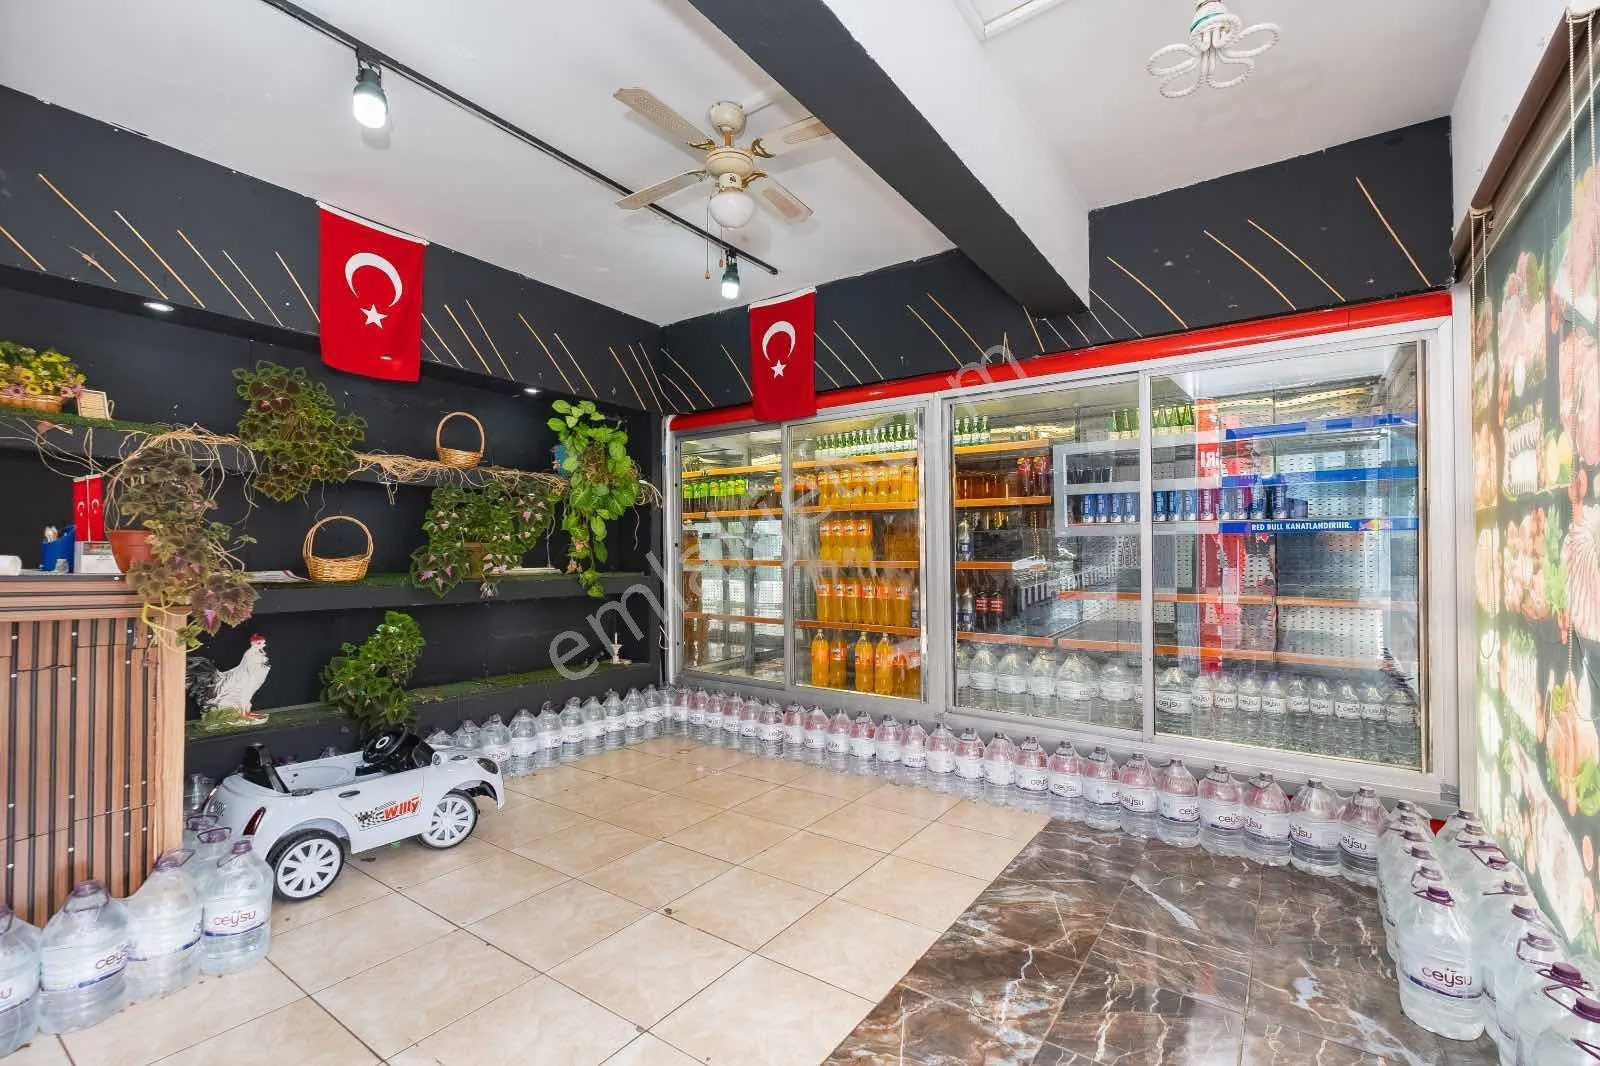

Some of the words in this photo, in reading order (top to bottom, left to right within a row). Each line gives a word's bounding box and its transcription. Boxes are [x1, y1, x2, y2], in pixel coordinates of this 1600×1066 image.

[1251, 521, 1265, 531] RED
[1266, 521, 1284, 531] BULL
[1178, 807, 1201, 817] ceys
[1217, 813, 1240, 825] ceys
[1342, 834, 1367, 851] eysu
